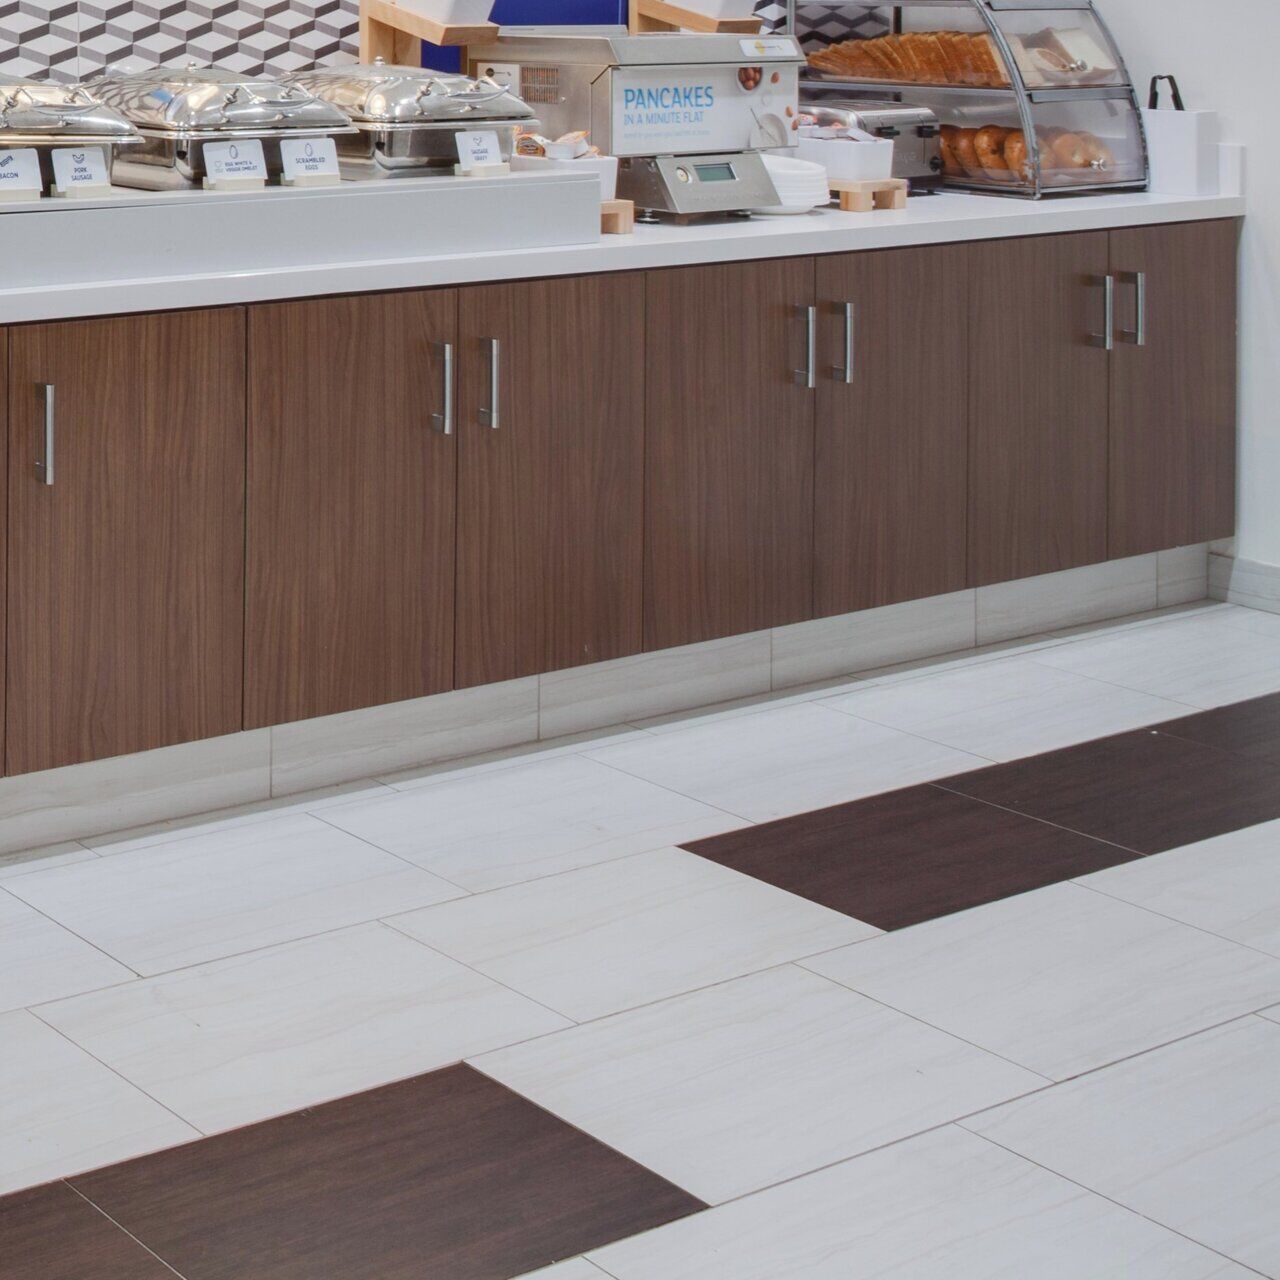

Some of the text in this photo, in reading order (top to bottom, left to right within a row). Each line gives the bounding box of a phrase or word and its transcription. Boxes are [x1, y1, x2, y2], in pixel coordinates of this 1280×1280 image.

[624, 86, 714, 110] PANCAKES
[646, 111, 681, 125] MINUTE
[683, 111, 704, 123] FLAT
